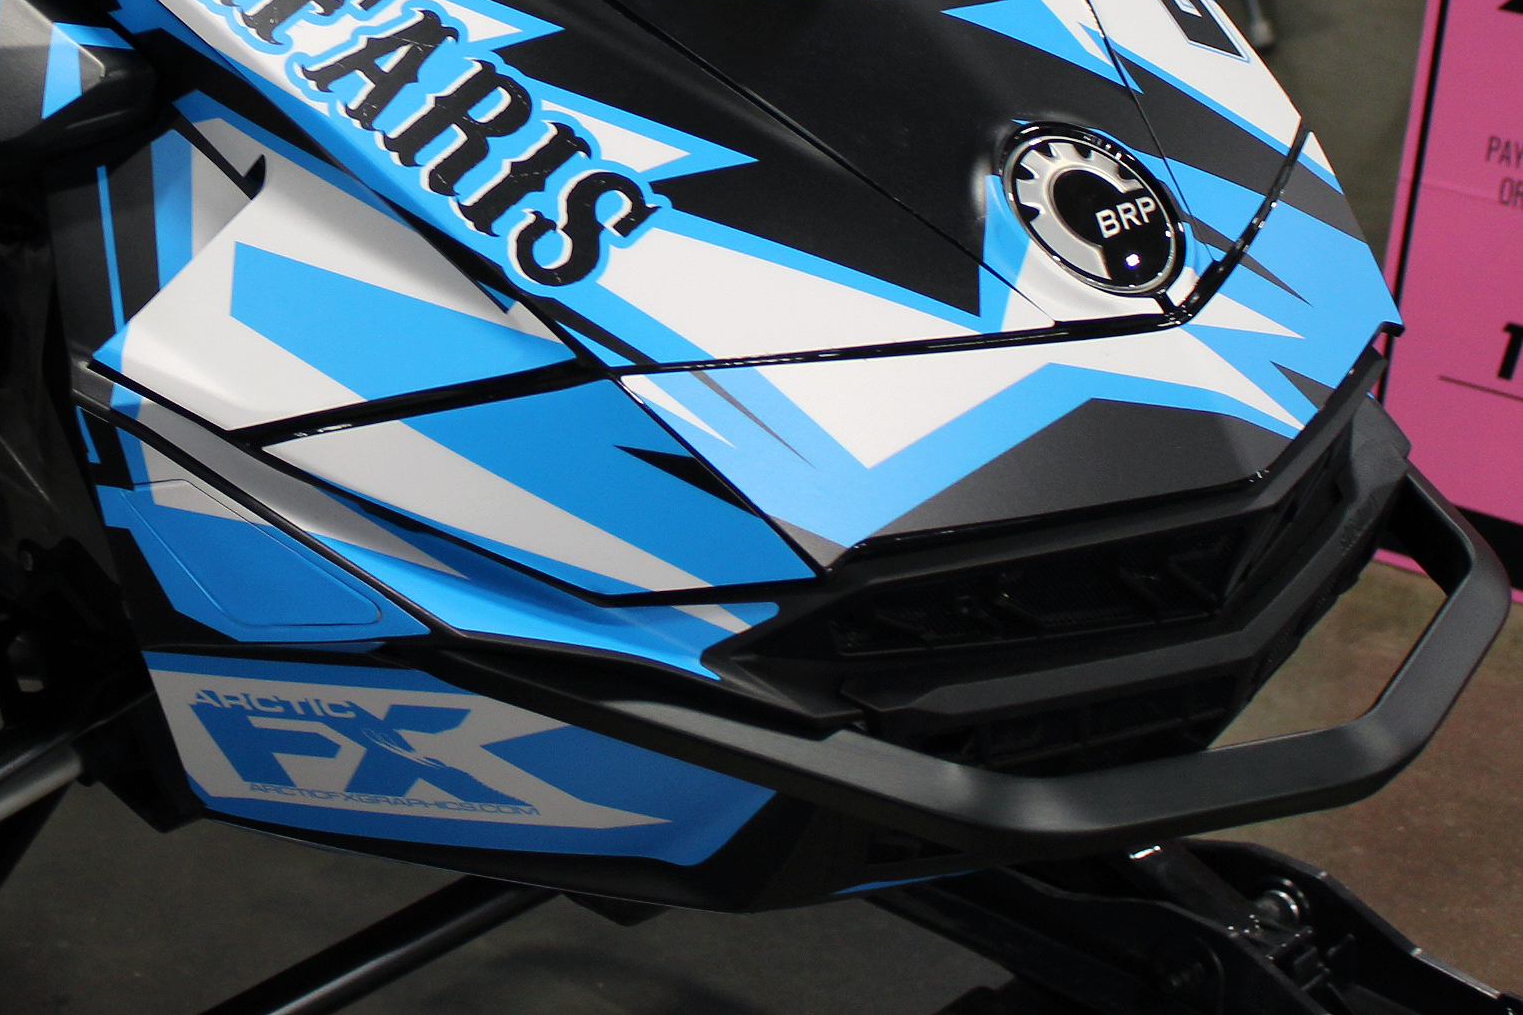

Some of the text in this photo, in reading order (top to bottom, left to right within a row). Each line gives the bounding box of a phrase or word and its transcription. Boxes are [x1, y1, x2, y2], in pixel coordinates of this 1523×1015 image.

[1094, 195, 1157, 239] BRP
[189, 689, 358, 720] ARCTIC
[188, 698, 535, 807] FX
